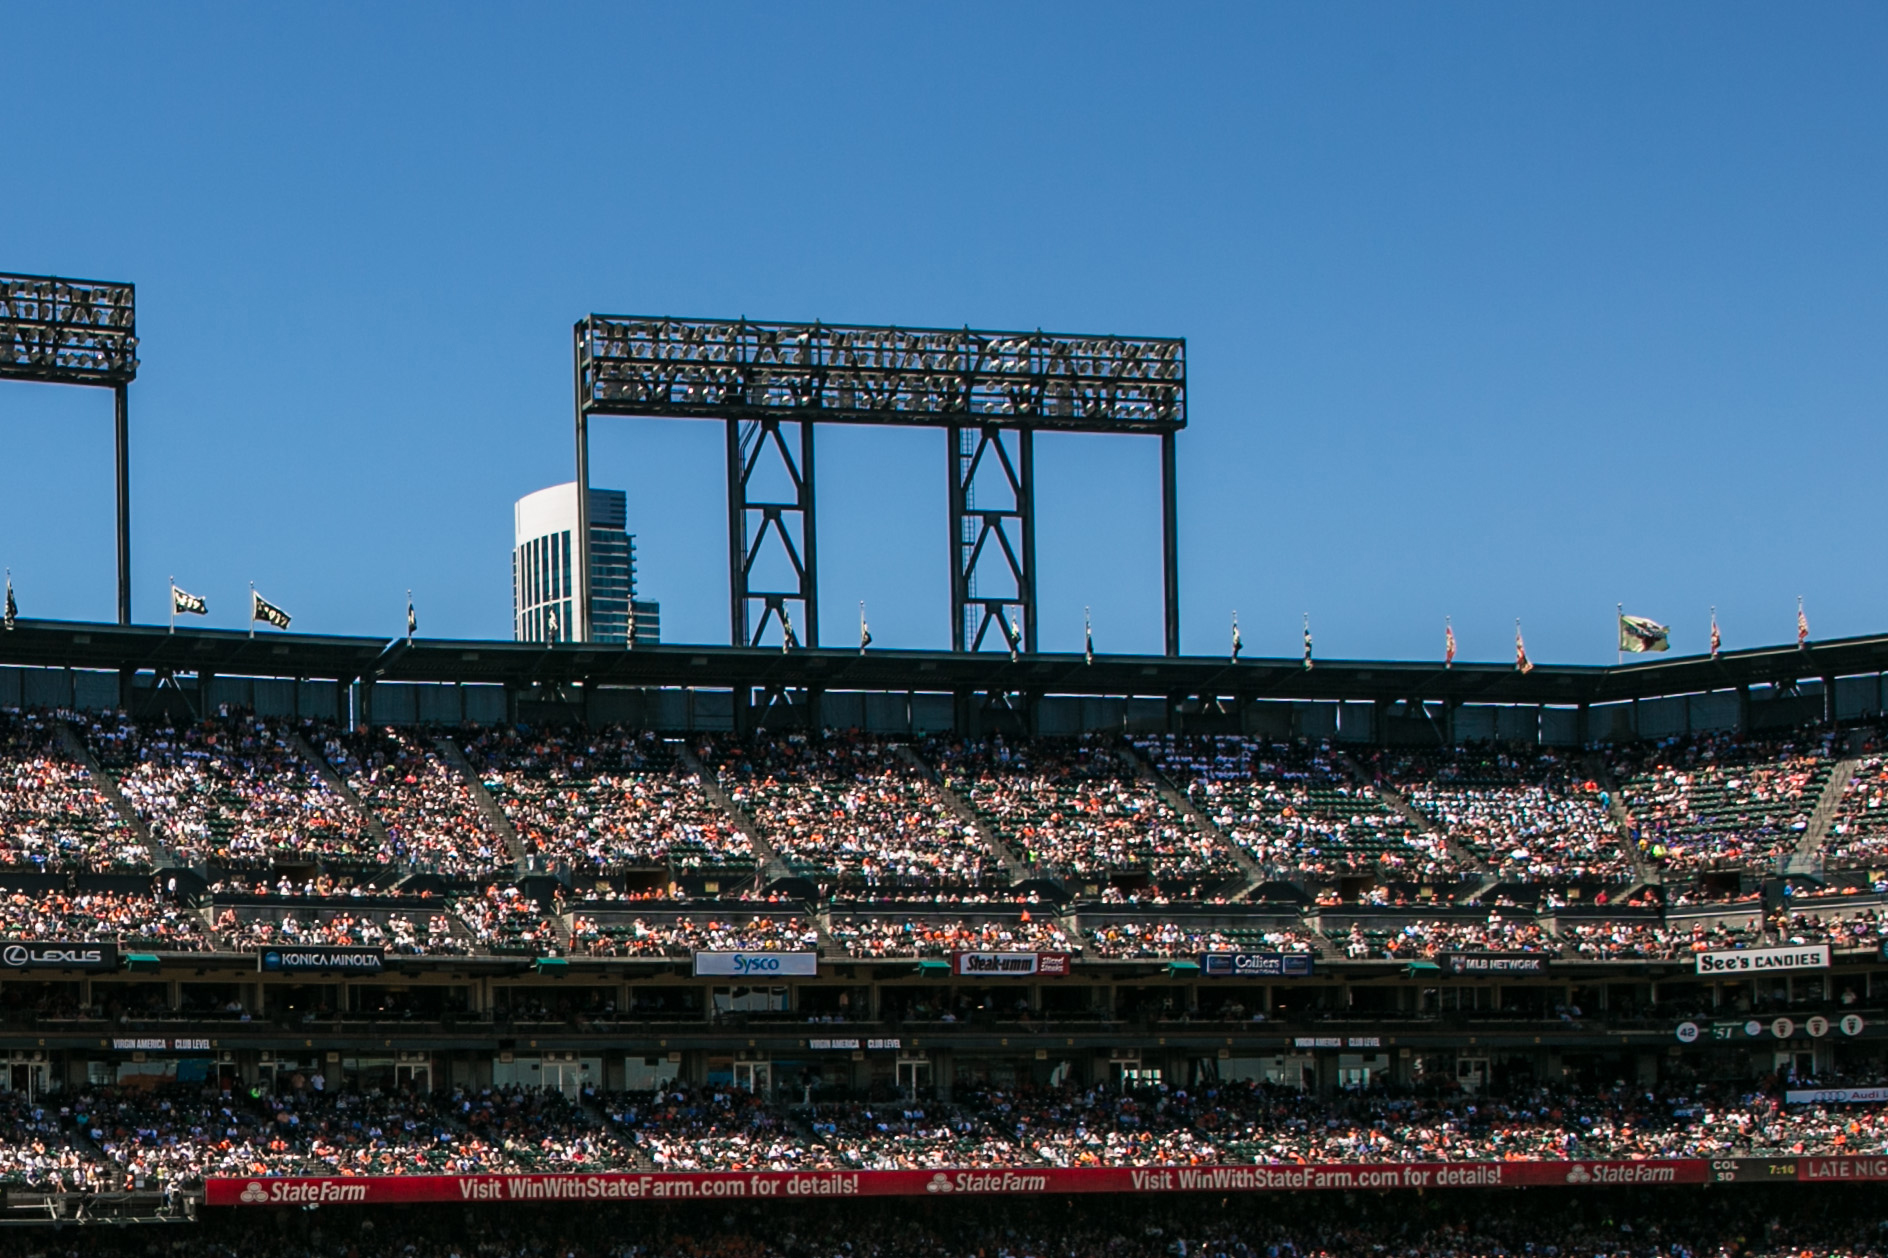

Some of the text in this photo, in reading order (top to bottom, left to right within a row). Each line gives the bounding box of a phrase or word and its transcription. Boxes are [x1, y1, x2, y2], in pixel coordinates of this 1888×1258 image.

[30, 950, 101, 962] LEXUS
[282, 953, 381, 966] KONICA MINOLTA
[1235, 954, 1280, 968] Colliers
[1701, 953, 1820, 971] See's CANDIES
[733, 954, 779, 974] Sysco
[966, 955, 1033, 972] Steak-umm
[1466, 959, 1540, 970] MLB NETWORK
[1679, 1027, 1695, 1037] 42
[113, 1038, 210, 1049] VIRGIN AMERICA CLUB LEVEL
[1851, 1091, 1879, 1099] Audi
[1712, 1161, 1739, 1170] COL
[1769, 1165, 1795, 1175] 7:10
[1808, 1161, 1850, 1178] LATE
[1131, 1165, 1502, 1190] Visit WinWithStateFarm.com for details!
[1717, 1172, 1735, 1181] SD
[459, 1173, 859, 1199] Visit WinWithStateFarm.com for details!
